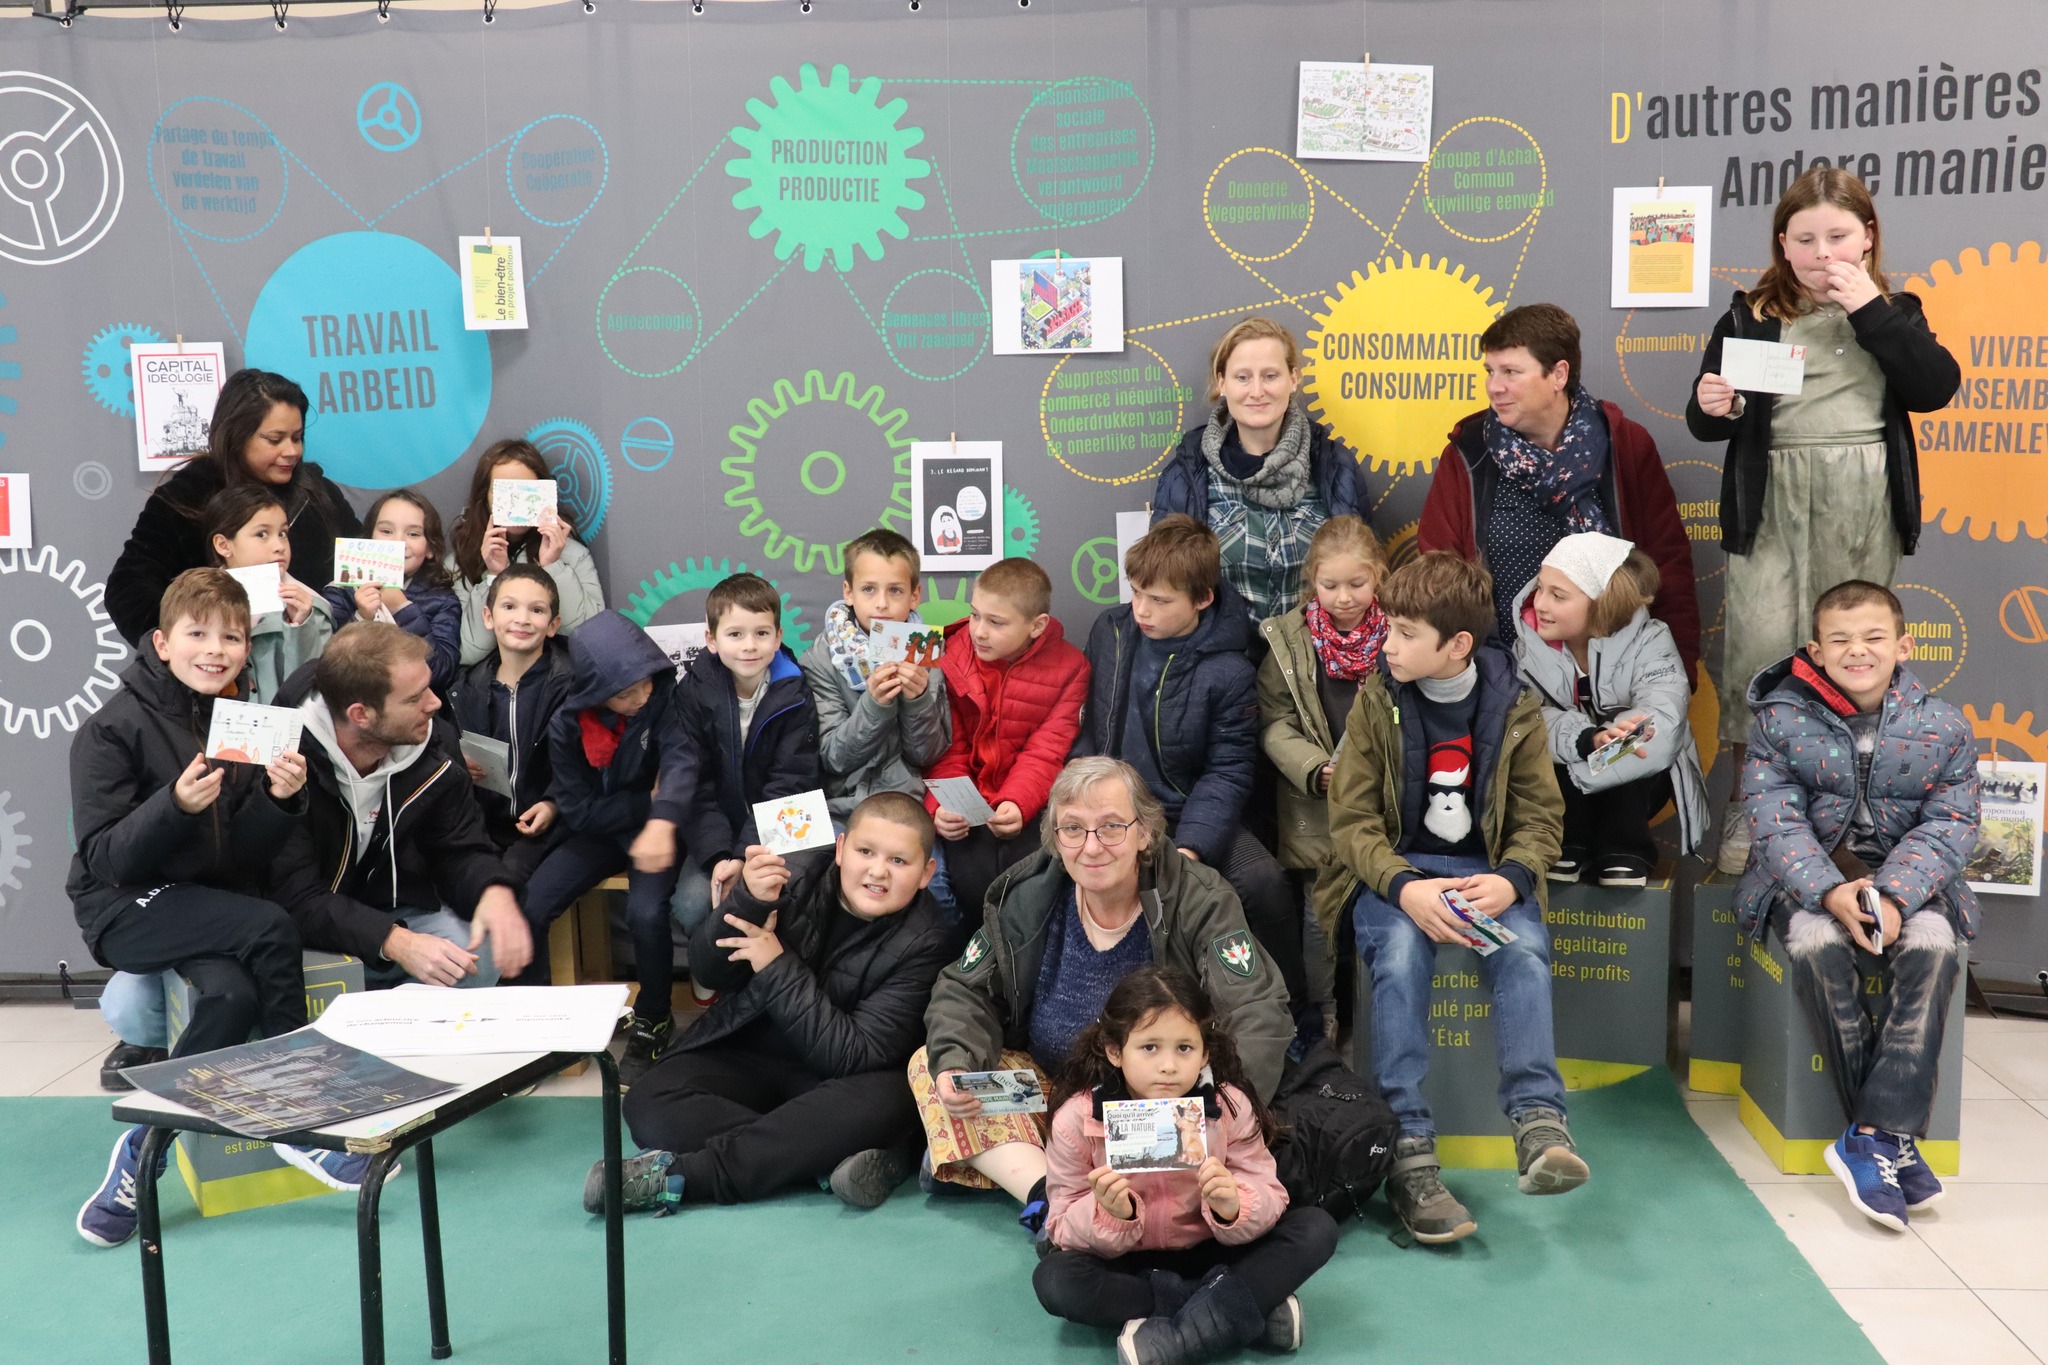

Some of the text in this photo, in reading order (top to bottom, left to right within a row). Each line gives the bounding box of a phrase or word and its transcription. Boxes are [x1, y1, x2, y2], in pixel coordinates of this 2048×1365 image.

[1610, 62, 2042, 144] D'autres manières
[1056, 107, 1105, 128] sociale
[211, 128, 228, 146] du
[1030, 128, 1137, 152] des entreprises
[181, 148, 246, 168] de travail
[771, 138, 888, 166] PRODUCTION
[1432, 147, 1538, 170] Groupe d'Achat
[172, 170, 259, 191] Verdelen van
[779, 176, 880, 202] PRODUCTIE
[1037, 172, 1123, 196] verantwoord
[1228, 180, 1288, 199] Donnerie
[1454, 171, 1515, 189] Commun
[182, 193, 257, 214] de werktijd
[1208, 201, 1311, 224] Weggeefwinkel
[1422, 193, 1491, 215] Vrijwillige
[494, 257, 506, 321] Le bien-être
[885, 309, 987, 328] Semences libres
[301, 308, 439, 358] TRAVAIL
[895, 331, 917, 350] Vrij
[1615, 332, 1696, 353] Community
[1969, 335, 2048, 368] VIVRE
[146, 360, 214, 373] CAPITAL
[147, 371, 214, 384] IDÉOLOGIE
[1056, 364, 1162, 390] Suppression du
[318, 365, 437, 415] ARBEID
[1340, 371, 1477, 401] CONSUMPTIE
[1943, 377, 2048, 411] NSEMB
[1039, 385, 1193, 413] commerce inéquitable
[1050, 409, 1173, 434] Onderdrukken van
[1047, 429, 1186, 457] de oneerlijke hande
[1554, 934, 1628, 956] égalitaire
[1550, 959, 1631, 983] des profits
[1464, 1003, 1492, 1022] par
[991, 1072, 1024, 1093] Liberté
[1122, 1112, 1136, 1120] qu'il
[1120, 1122, 1156, 1133] LA NATURE
[224, 1141, 243, 1155] est
